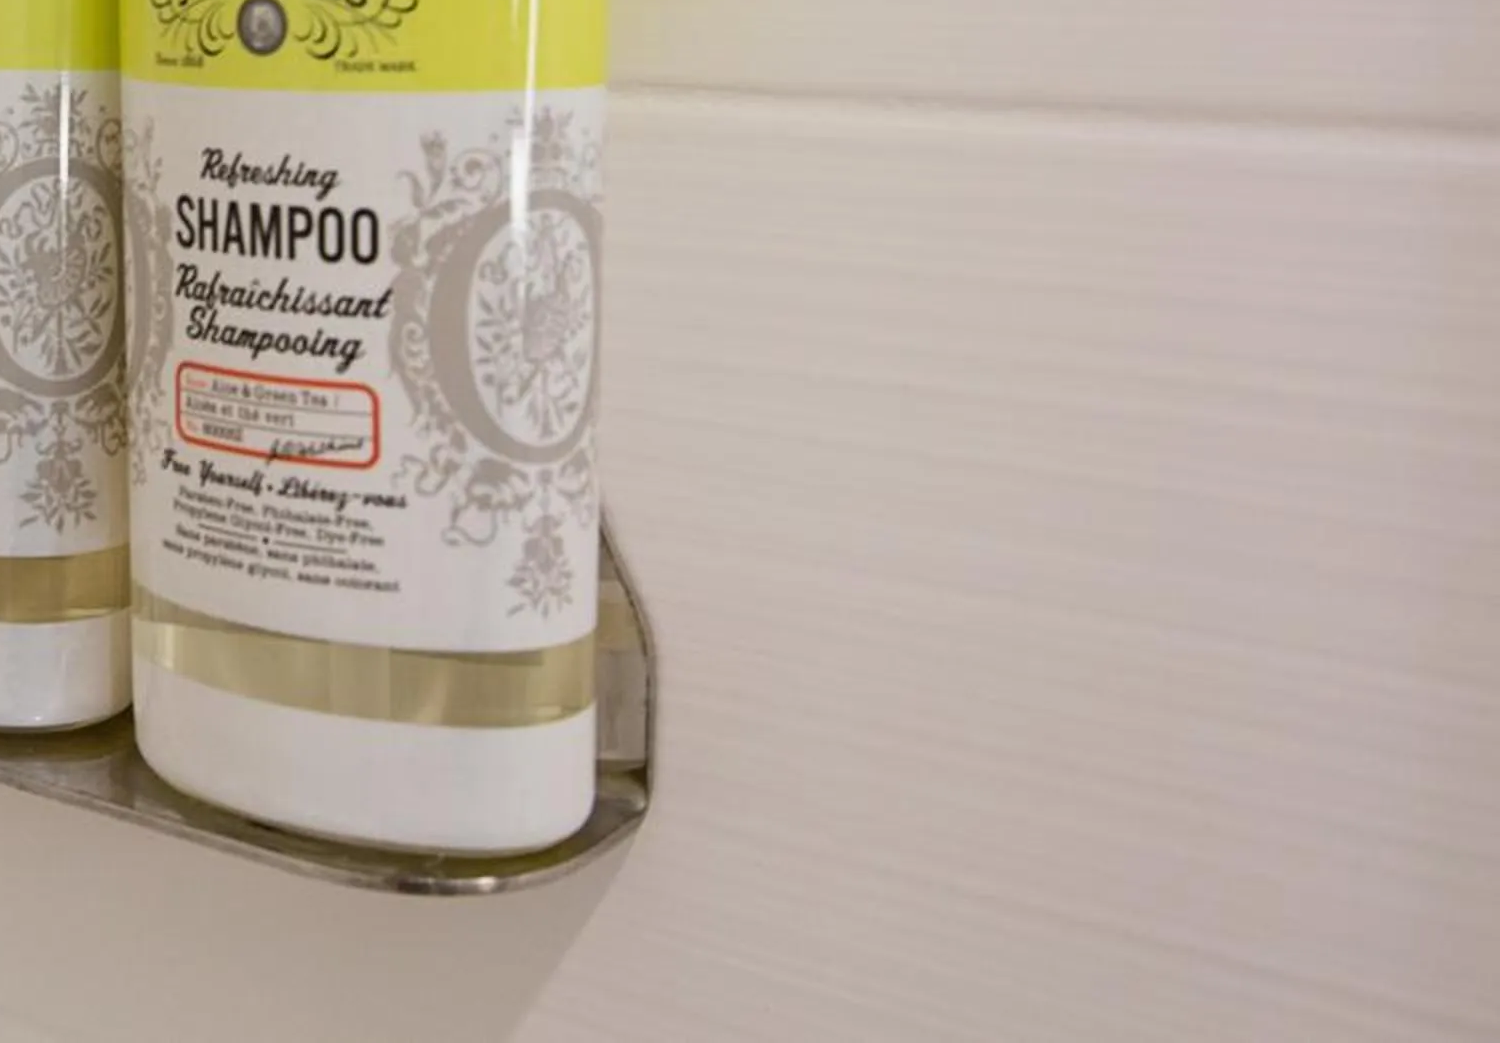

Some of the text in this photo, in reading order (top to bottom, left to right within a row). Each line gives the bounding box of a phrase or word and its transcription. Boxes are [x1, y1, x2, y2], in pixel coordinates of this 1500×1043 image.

[200, 147, 339, 201] Refreshing
[176, 194, 379, 265] SHAMPOO
[186, 305, 364, 373] Shampooing
[242, 384, 250, 398] &
[254, 385, 298, 403] Green
[302, 391, 328, 406] Tea
[199, 460, 264, 496] Yourself
